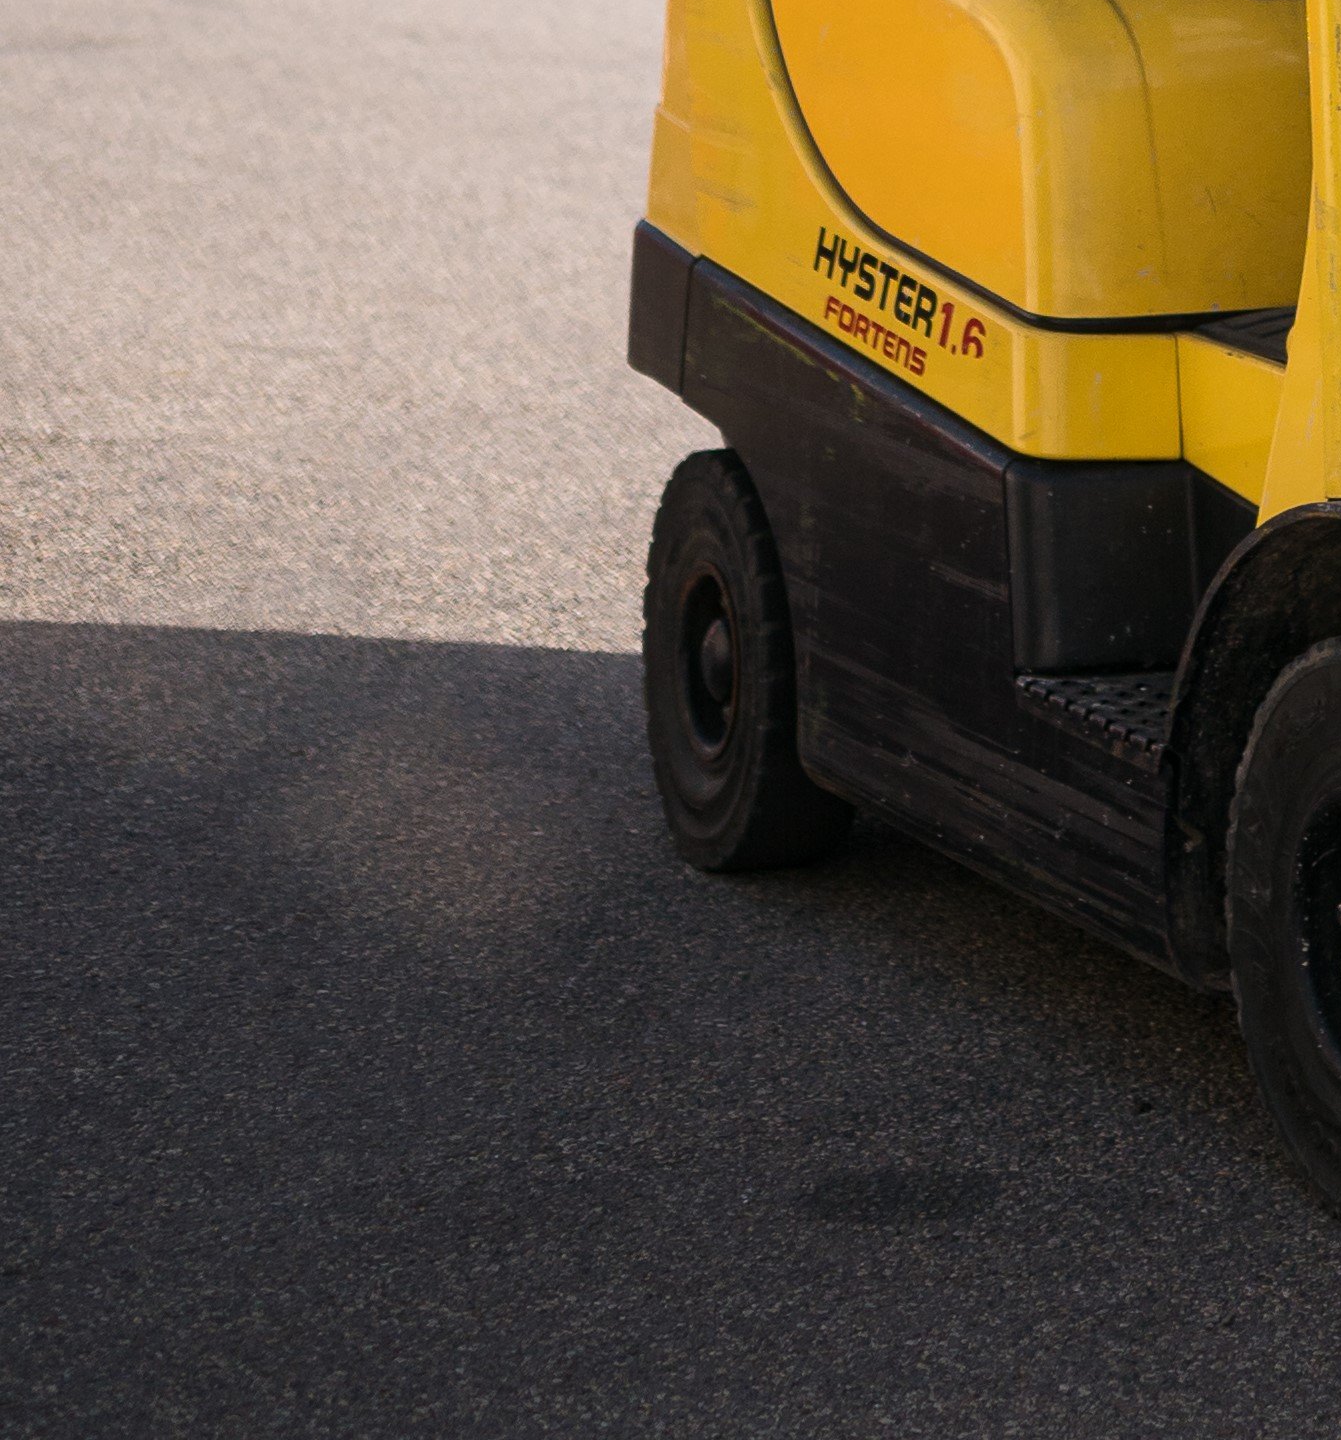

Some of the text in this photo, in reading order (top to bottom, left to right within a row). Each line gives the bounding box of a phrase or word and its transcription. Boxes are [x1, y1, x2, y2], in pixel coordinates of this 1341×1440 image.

[813, 226, 987, 359] HYSTER 1.6
[823, 295, 928, 377] FORTENS
